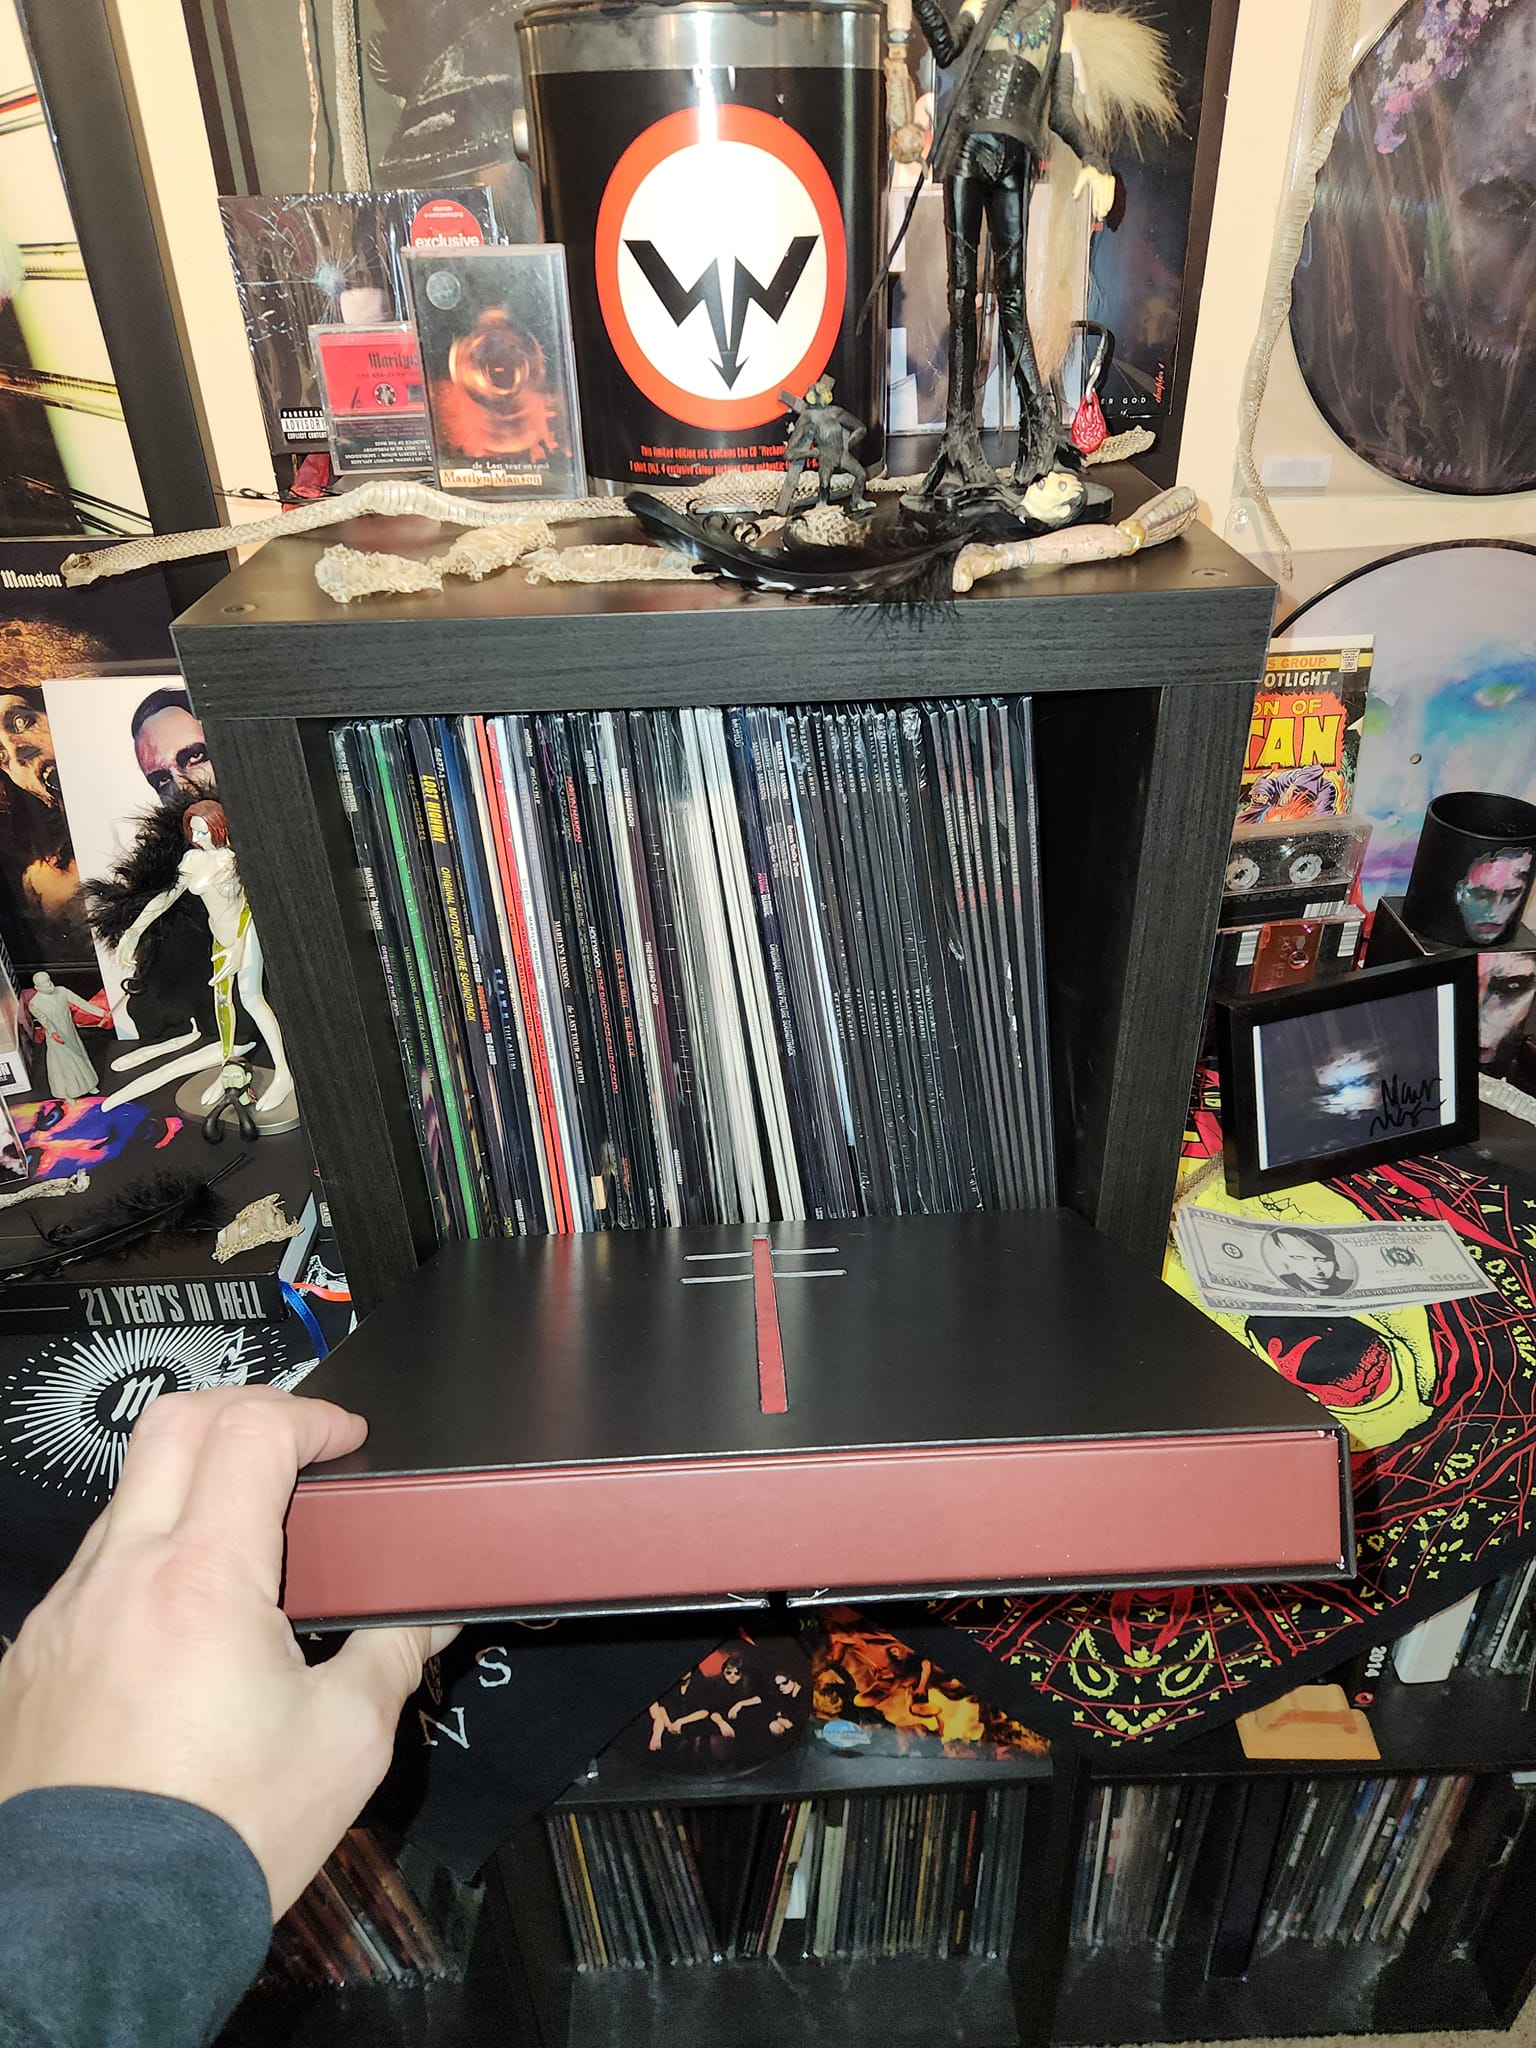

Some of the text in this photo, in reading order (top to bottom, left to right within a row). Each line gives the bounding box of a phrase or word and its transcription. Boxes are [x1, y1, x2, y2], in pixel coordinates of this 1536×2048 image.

[415, 233, 480, 247] exclusive
[285, 419, 326, 430] ADVISORY
[288, 432, 307, 440] EXPLICIT
[444, 471, 541, 484] Marilyn Manson
[1, 570, 63, 589] Manson
[1253, 699, 1322, 717] ON OF
[523, 728, 534, 757] nothing
[751, 741, 762, 771] MARILYN
[774, 741, 785, 770] MARILYN
[620, 768, 632, 797] MARILYN
[756, 773, 768, 800] MANSON
[778, 772, 790, 800] MANSON
[806, 766, 816, 796] MANSON
[566, 776, 576, 808] MARILYN
[571, 810, 582, 843] MANSON
[624, 798, 636, 828] MANSON
[815, 724, 824, 757] MARILYN
[820, 761, 830, 792] MANSON
[856, 988, 862, 997] WE
[364, 867, 383, 930] MARILYN MANSON
[422, 774, 476, 1021] LOST HIGHWAY ORIGINAL MOTION PICTURE SOUNDTRACK
[553, 920, 566, 955] MARILYN
[644, 942, 652, 954] THE
[381, 946, 392, 974] GENESIS
[768, 944, 780, 970] ORIGINAL
[386, 975, 394, 984] OF
[528, 916, 538, 948] MARILYN
[534, 950, 542, 980] MANSON
[540, 989, 550, 1030] MECHANICAL
[559, 956, 570, 988] MANSON
[774, 972, 784, 996] MOTION
[516, 954, 528, 994] MARILYN
[523, 996, 532, 1032] MANSON
[520, 926, 546, 1060] MARILYN MANSON MECHANICAL ANIMALS
[619, 981, 628, 1008] FORGET
[778, 996, 789, 1018] PICTURE
[566, 1005, 574, 1014] the
[568, 1014, 576, 1032] LAST
[570, 1032, 580, 1053] TOUR
[782, 1020, 796, 1056] SOUNDTRACK
[486, 1045, 497, 1065] ALBUM
[506, 1044, 516, 1070] ALBUM
[575, 1060, 585, 1084] EARTH
[78, 1287, 113, 1326] 21
[214, 1281, 267, 1320] HELL
[1364, 1646, 1388, 1678] 2014
